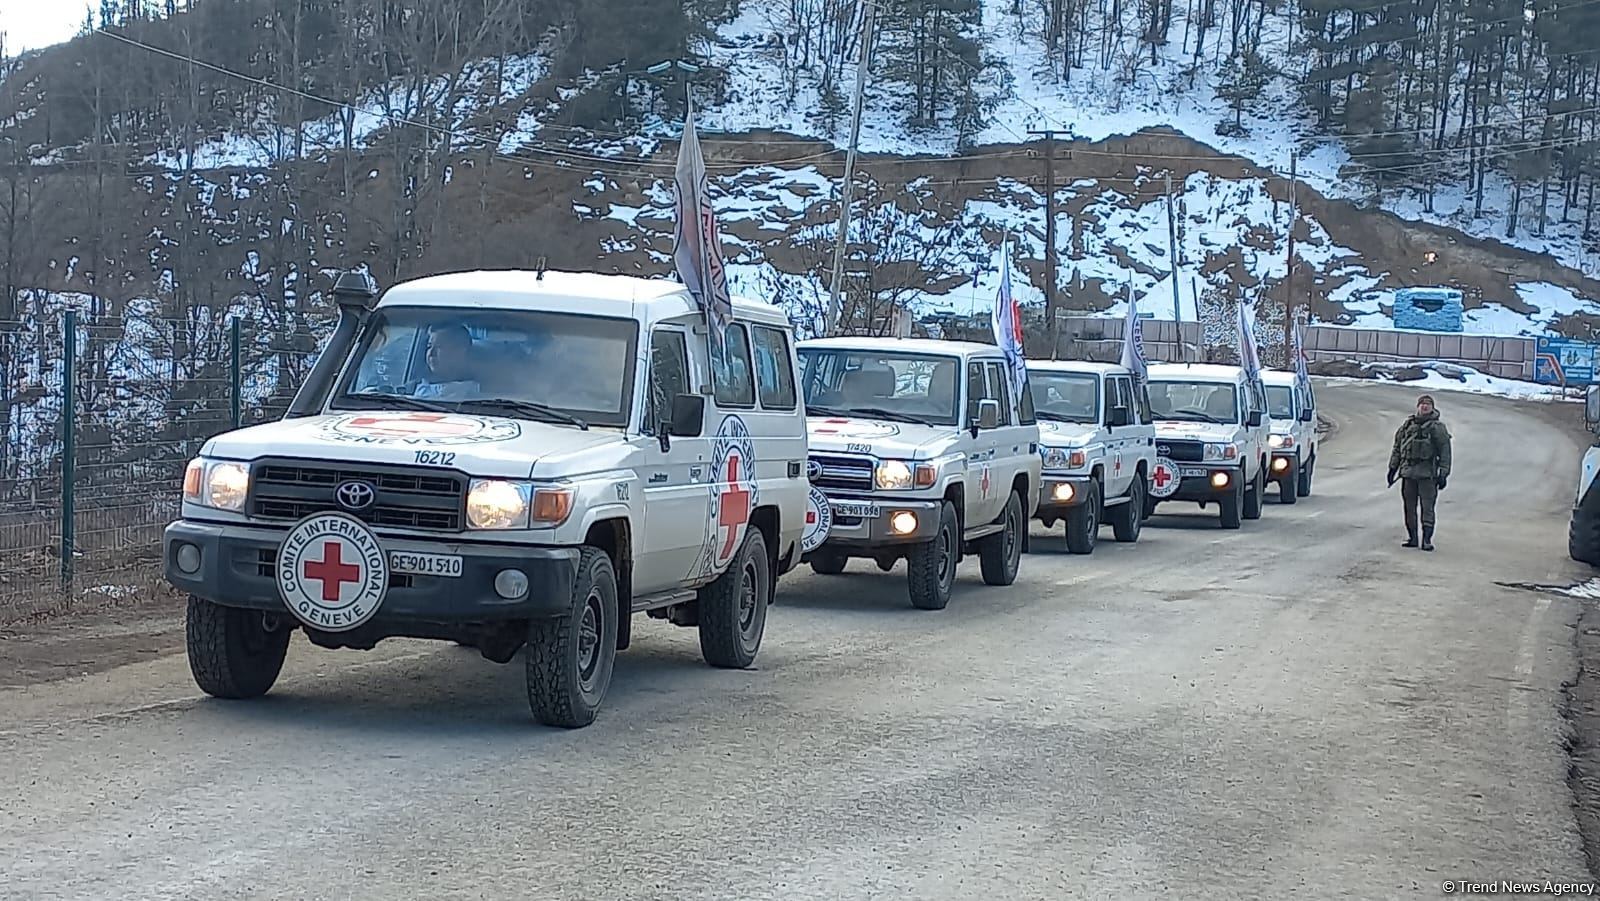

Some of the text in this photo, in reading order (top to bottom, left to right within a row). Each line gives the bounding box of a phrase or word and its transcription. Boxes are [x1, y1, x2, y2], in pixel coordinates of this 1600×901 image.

[413, 450, 456, 466] 16212
[282, 519, 383, 599] COMITE INTERNATIONAL
[298, 600, 365, 625] GENEVE
